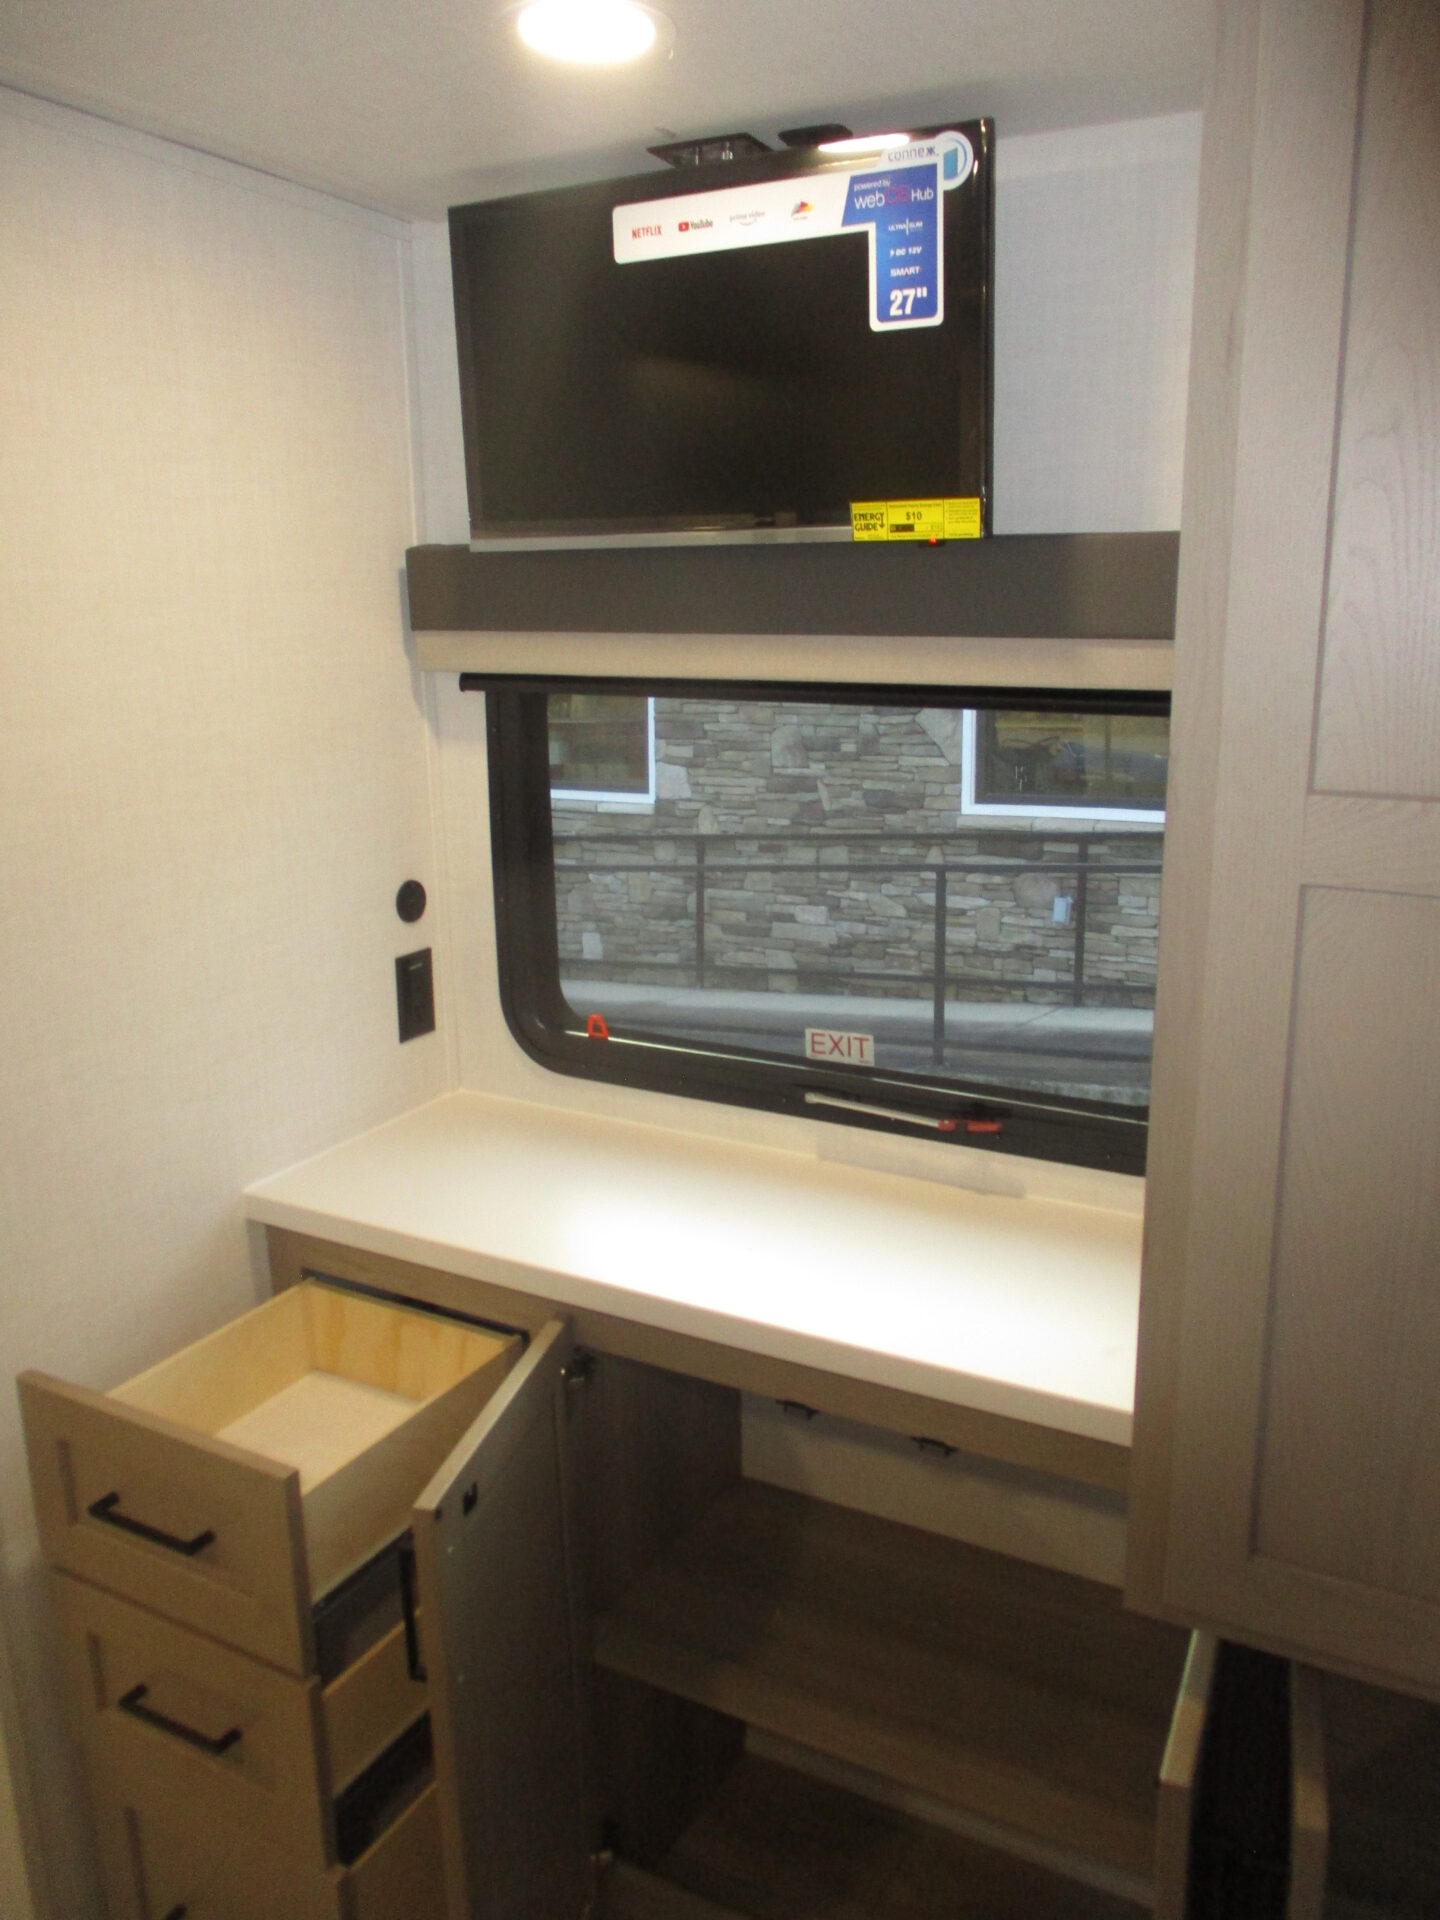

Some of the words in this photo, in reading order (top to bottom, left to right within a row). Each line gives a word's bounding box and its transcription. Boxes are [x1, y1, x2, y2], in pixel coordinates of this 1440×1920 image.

[911, 187, 934, 202] Hub
[690, 219, 713, 231] YouTube
[631, 225, 662, 240] NETFLIX
[890, 266, 920, 277] SMART
[889, 286, 928, 316] 27"
[853, 512, 884, 522] ENERGY
[905, 511, 923, 521] $10
[854, 523, 879, 532] GUIDE
[811, 1032, 869, 1058] EXIT
